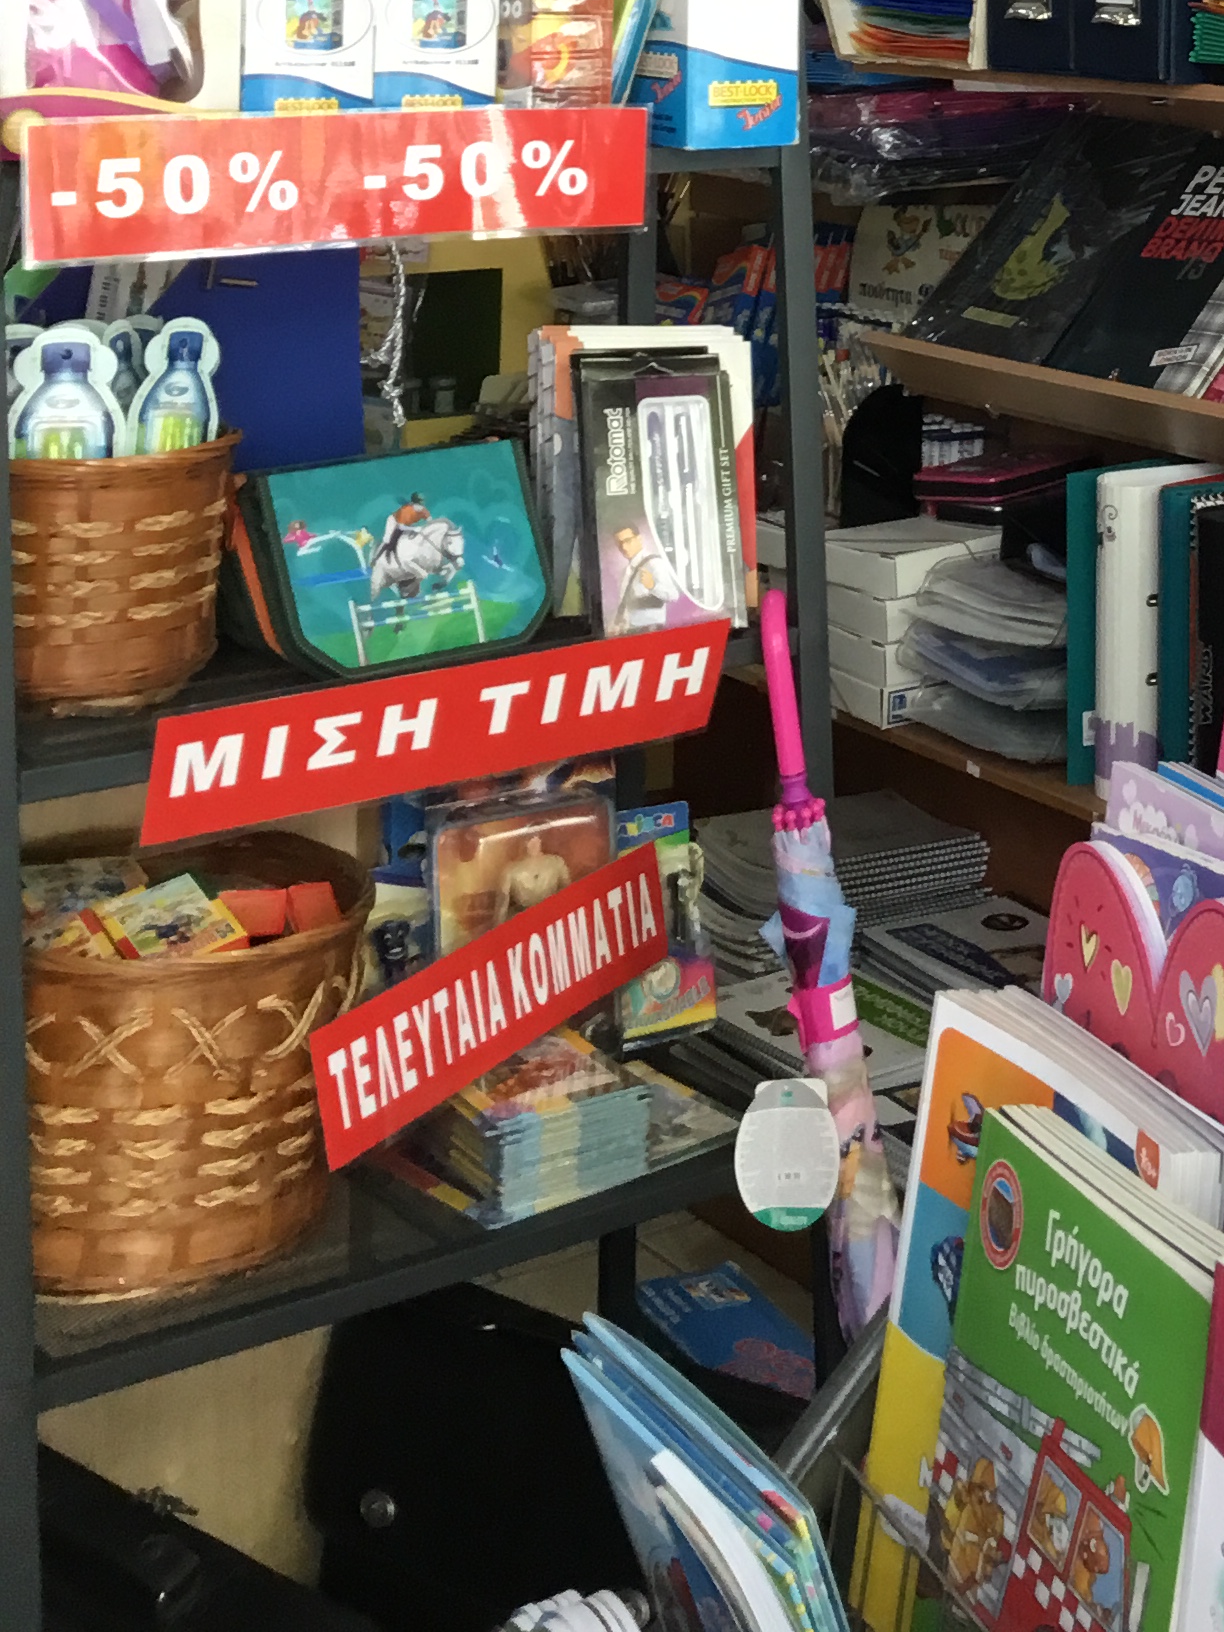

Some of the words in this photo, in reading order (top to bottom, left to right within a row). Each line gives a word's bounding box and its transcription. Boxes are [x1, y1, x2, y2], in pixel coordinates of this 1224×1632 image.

[735, 94, 783, 131] Junior
[603, 407, 629, 496] Rotomac
[718, 448, 730, 467] SET
[720, 471, 732, 497] GIFT
[722, 499, 737, 554] PREMIUM
[168, 698, 438, 799] ΜΙΣΗ
[479, 646, 711, 736] ΤΙΜΗ
[327, 960, 508, 1130] ΤΕΛΕΥΤΑΙΑ
[506, 872, 658, 1021] ΚΟΜΜΑΤΙΑ
[1045, 1208, 1130, 1320] Γρήγορα
[1008, 1301, 1041, 1352] Βιβλίο
[1039, 1333, 1130, 1437] δραστηριοτήτων
[1014, 1263, 1140, 1400] πυροσβεστικά
